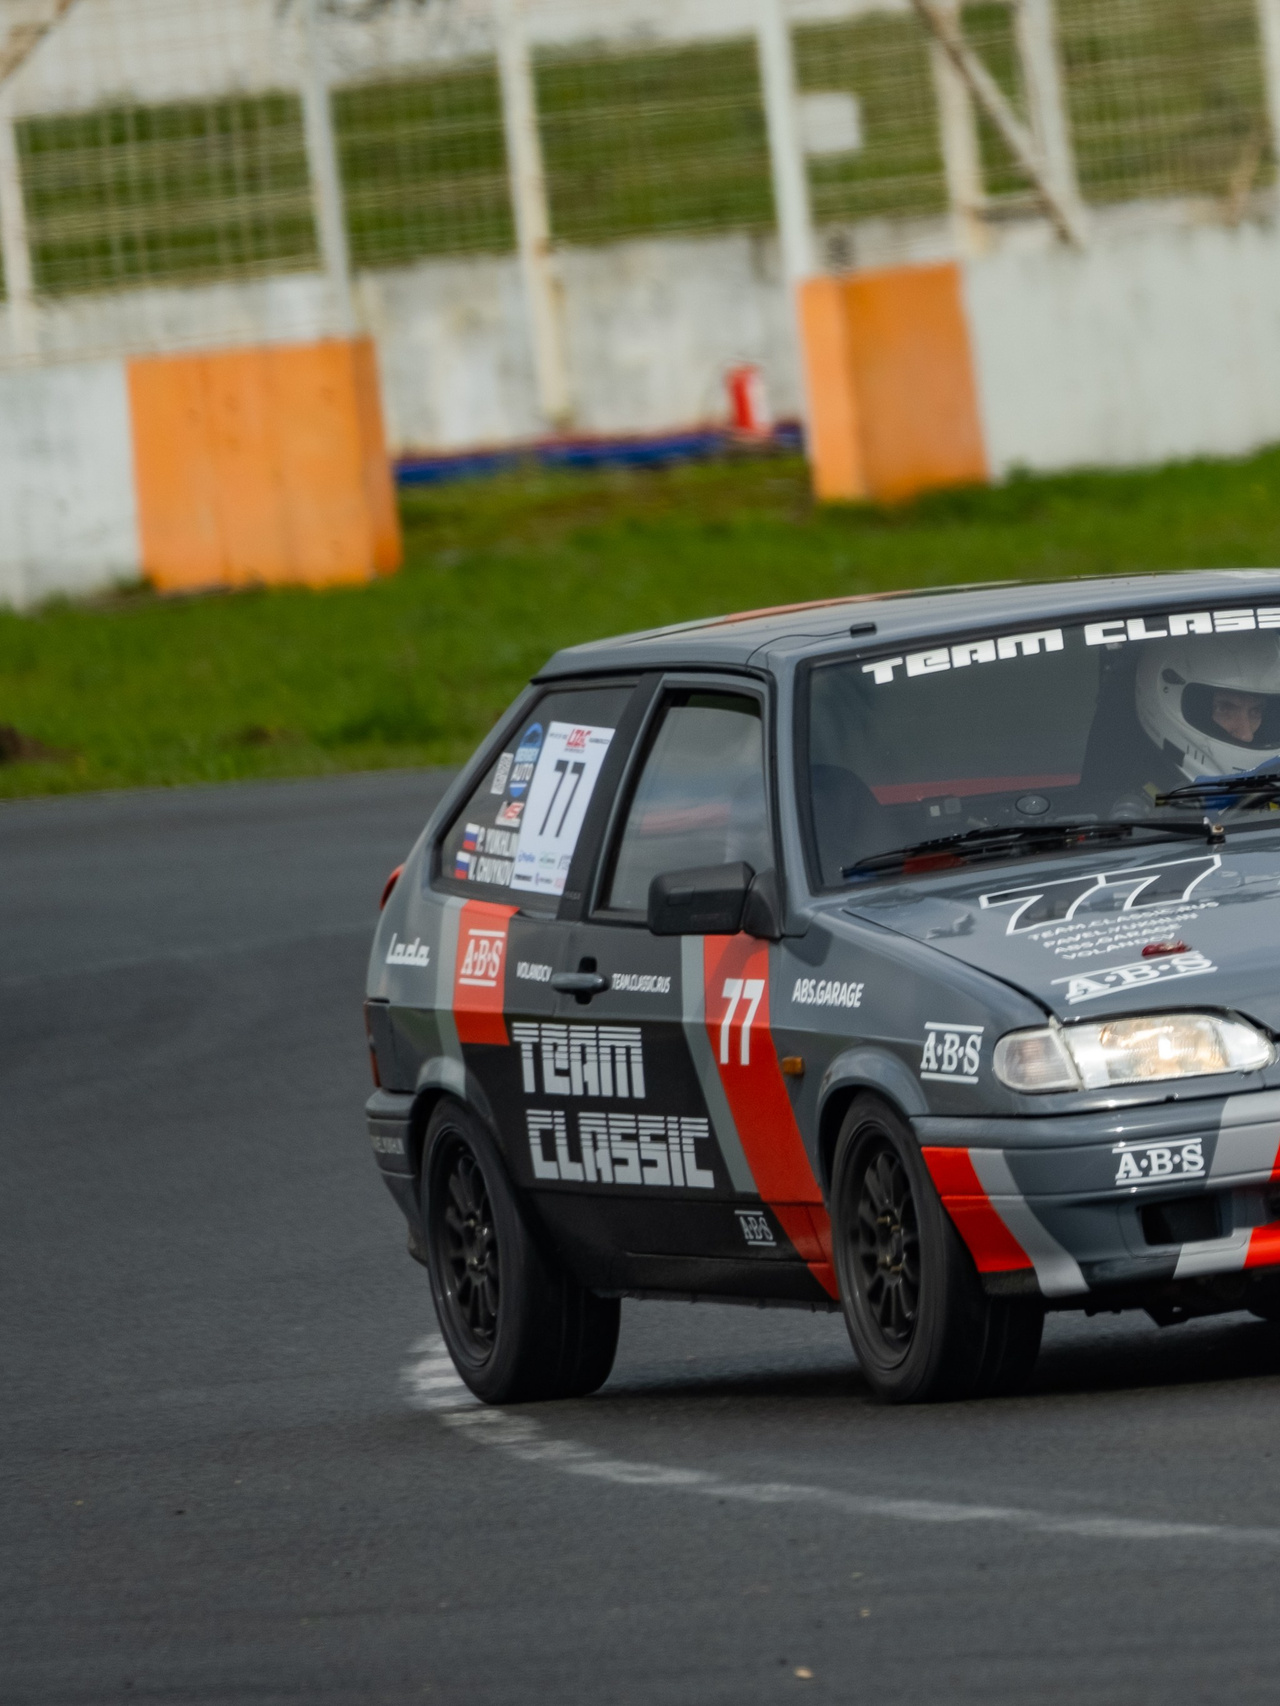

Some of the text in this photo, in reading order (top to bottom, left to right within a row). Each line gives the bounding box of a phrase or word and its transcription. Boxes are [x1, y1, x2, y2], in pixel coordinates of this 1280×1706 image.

[862, 629, 1064, 684] TEAM
[511, 764, 535, 781] AUTO
[539, 760, 587, 838] 77
[979, 854, 1222, 936] 77
[720, 978, 765, 1065] 77
[791, 978, 864, 1008] ABS.GARAGE
[512, 1022, 645, 1098] TEAM
[526, 1109, 715, 1188] CLASSIC
